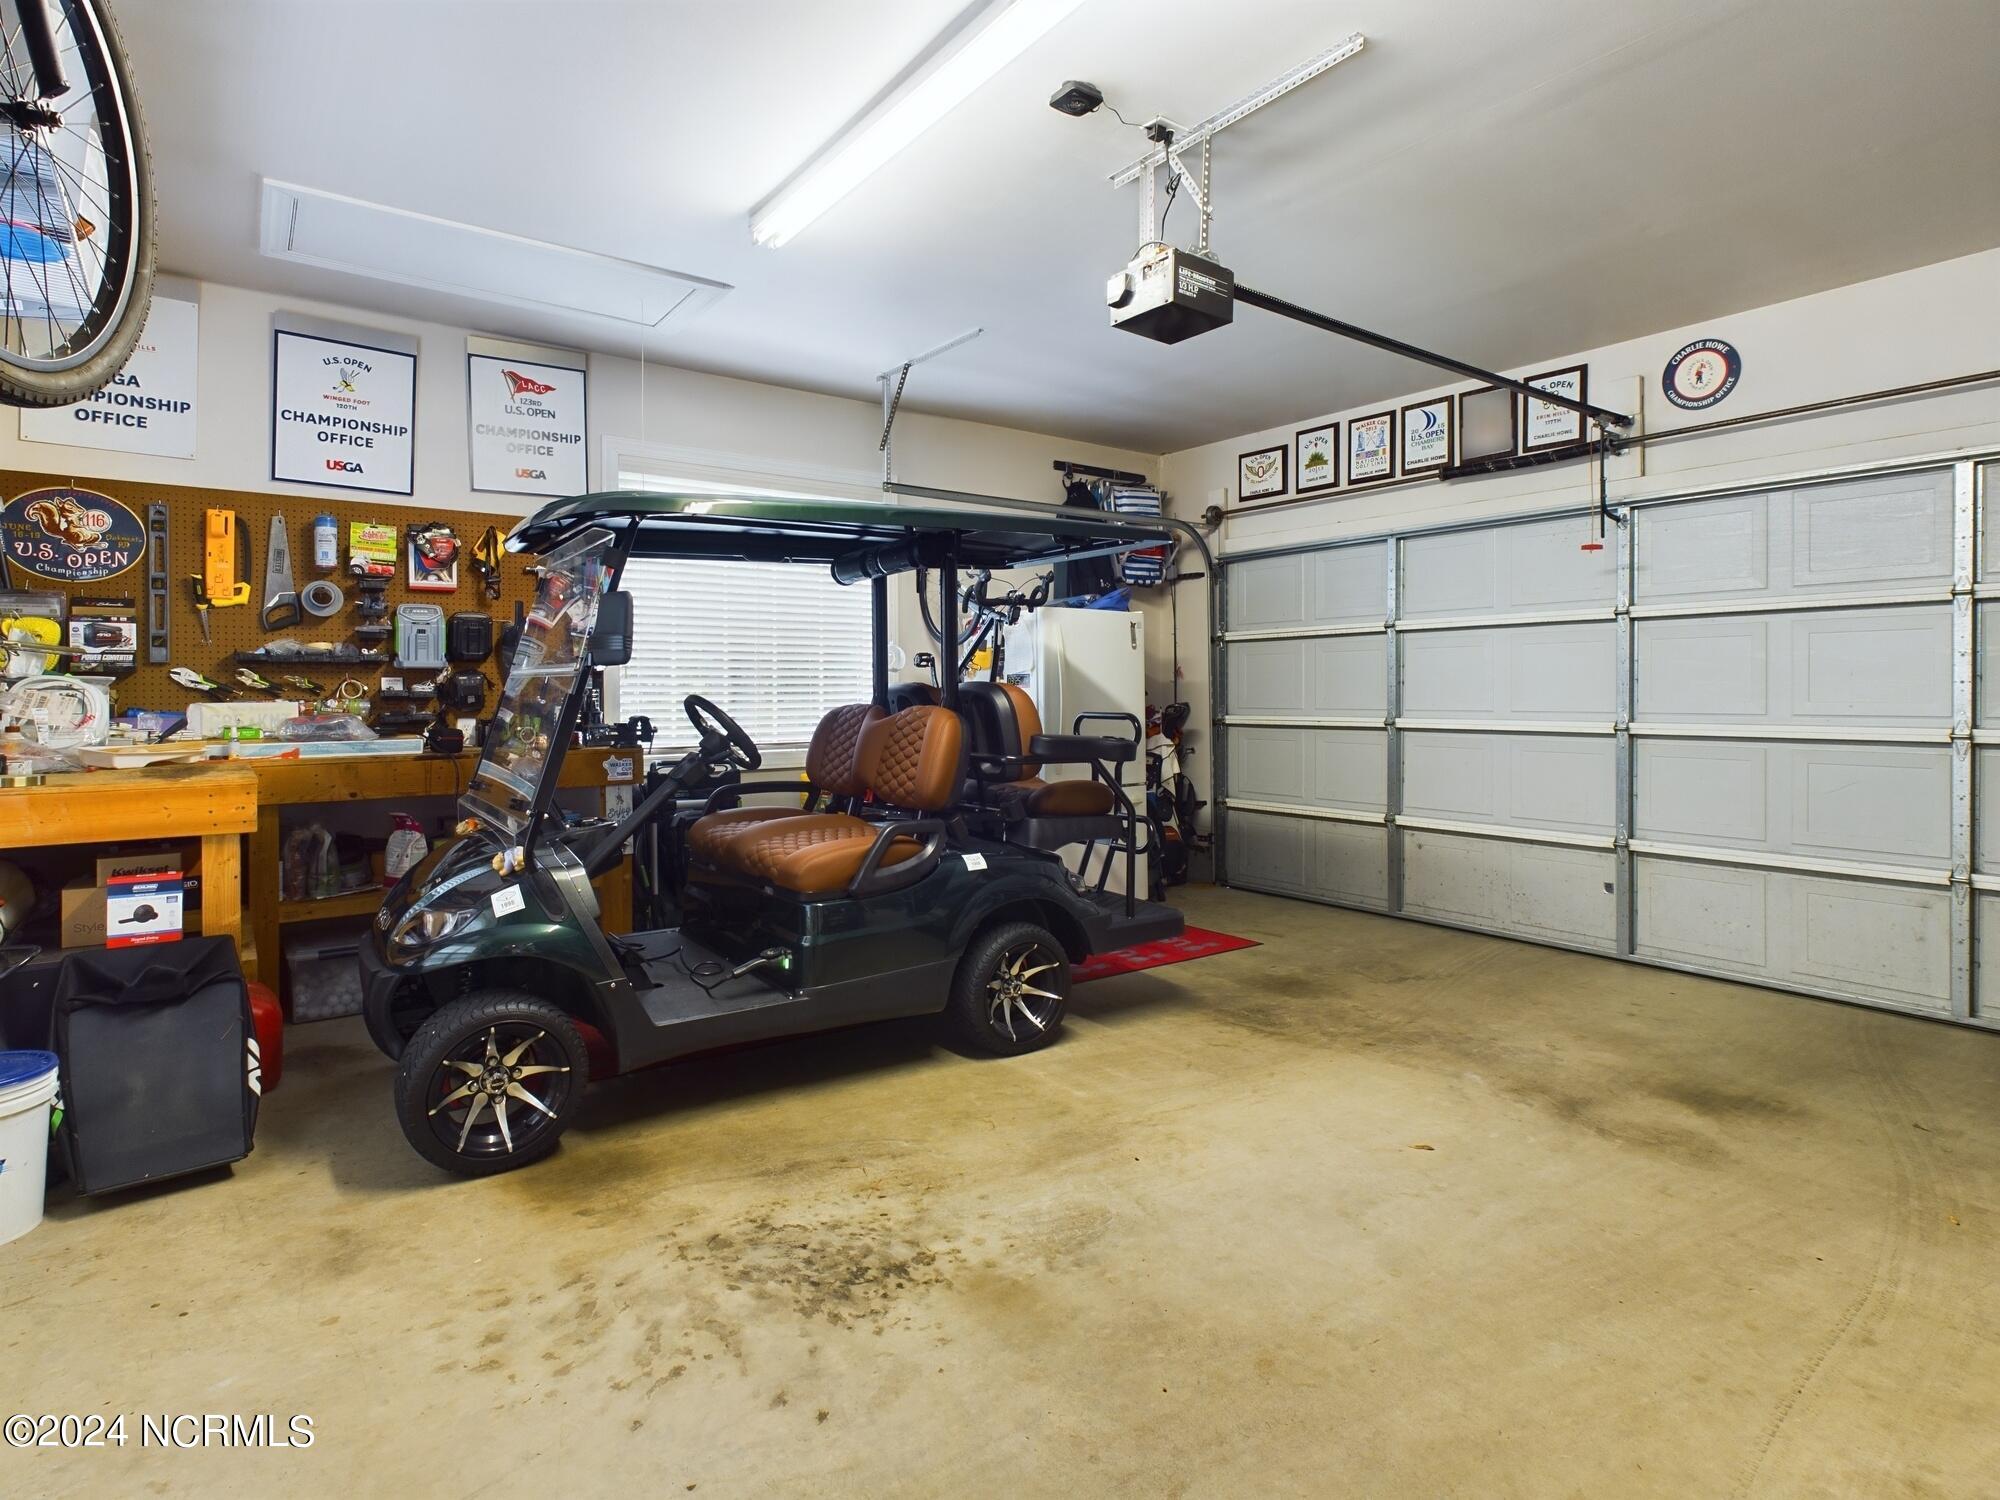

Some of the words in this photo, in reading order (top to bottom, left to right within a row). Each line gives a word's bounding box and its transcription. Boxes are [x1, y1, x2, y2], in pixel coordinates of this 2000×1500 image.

[1671, 342, 1705, 365] CHARLIE
[1705, 341, 1730, 354] HOWE
[323, 357, 342, 366] U.S.
[343, 357, 372, 373] OPEN
[112, 373, 140, 388] GA
[521, 380, 546, 393] LACC
[1549, 380, 1574, 389] OPEN
[323, 394, 352, 402] WINGED
[1667, 390, 1715, 407] CHAMPIONSHIP
[1715, 376, 1735, 399] OFFICE
[88, 391, 191, 414] PIONSHIP
[520, 397, 542, 406] 123RD
[74, 408, 148, 428] OFFICE
[504, 404, 525, 416] U.S.
[526, 407, 556, 419] OPEN
[281, 409, 408, 437] CHAMPIONSHIP
[317, 431, 374, 448] OFFICE
[475, 423, 581, 444] CHAMPIONSHIP
[1314, 436, 1328, 445] OPEN
[1411, 433, 1425, 442] U.S.
[1425, 428, 1445, 439] OPEN
[1533, 432, 1555, 441] CHARLIE
[1556, 428, 1573, 436] HOWE
[506, 442, 554, 456] OFFICE
[326, 459, 364, 473] USGA
[1356, 456, 1387, 465] NATIONAL
[1407, 457, 1429, 466] CHARLIE
[1430, 454, 1447, 462] HOWE
[515, 468, 547, 480] USGA
[2, 522, 32, 531] JUNE
[85, 513, 105, 528] 116
[14, 541, 59, 560] U.S.
[67, 551, 129, 568] OPEN
[36, 563, 109, 578] Championship
[112, 865, 170, 877] Kwikset
